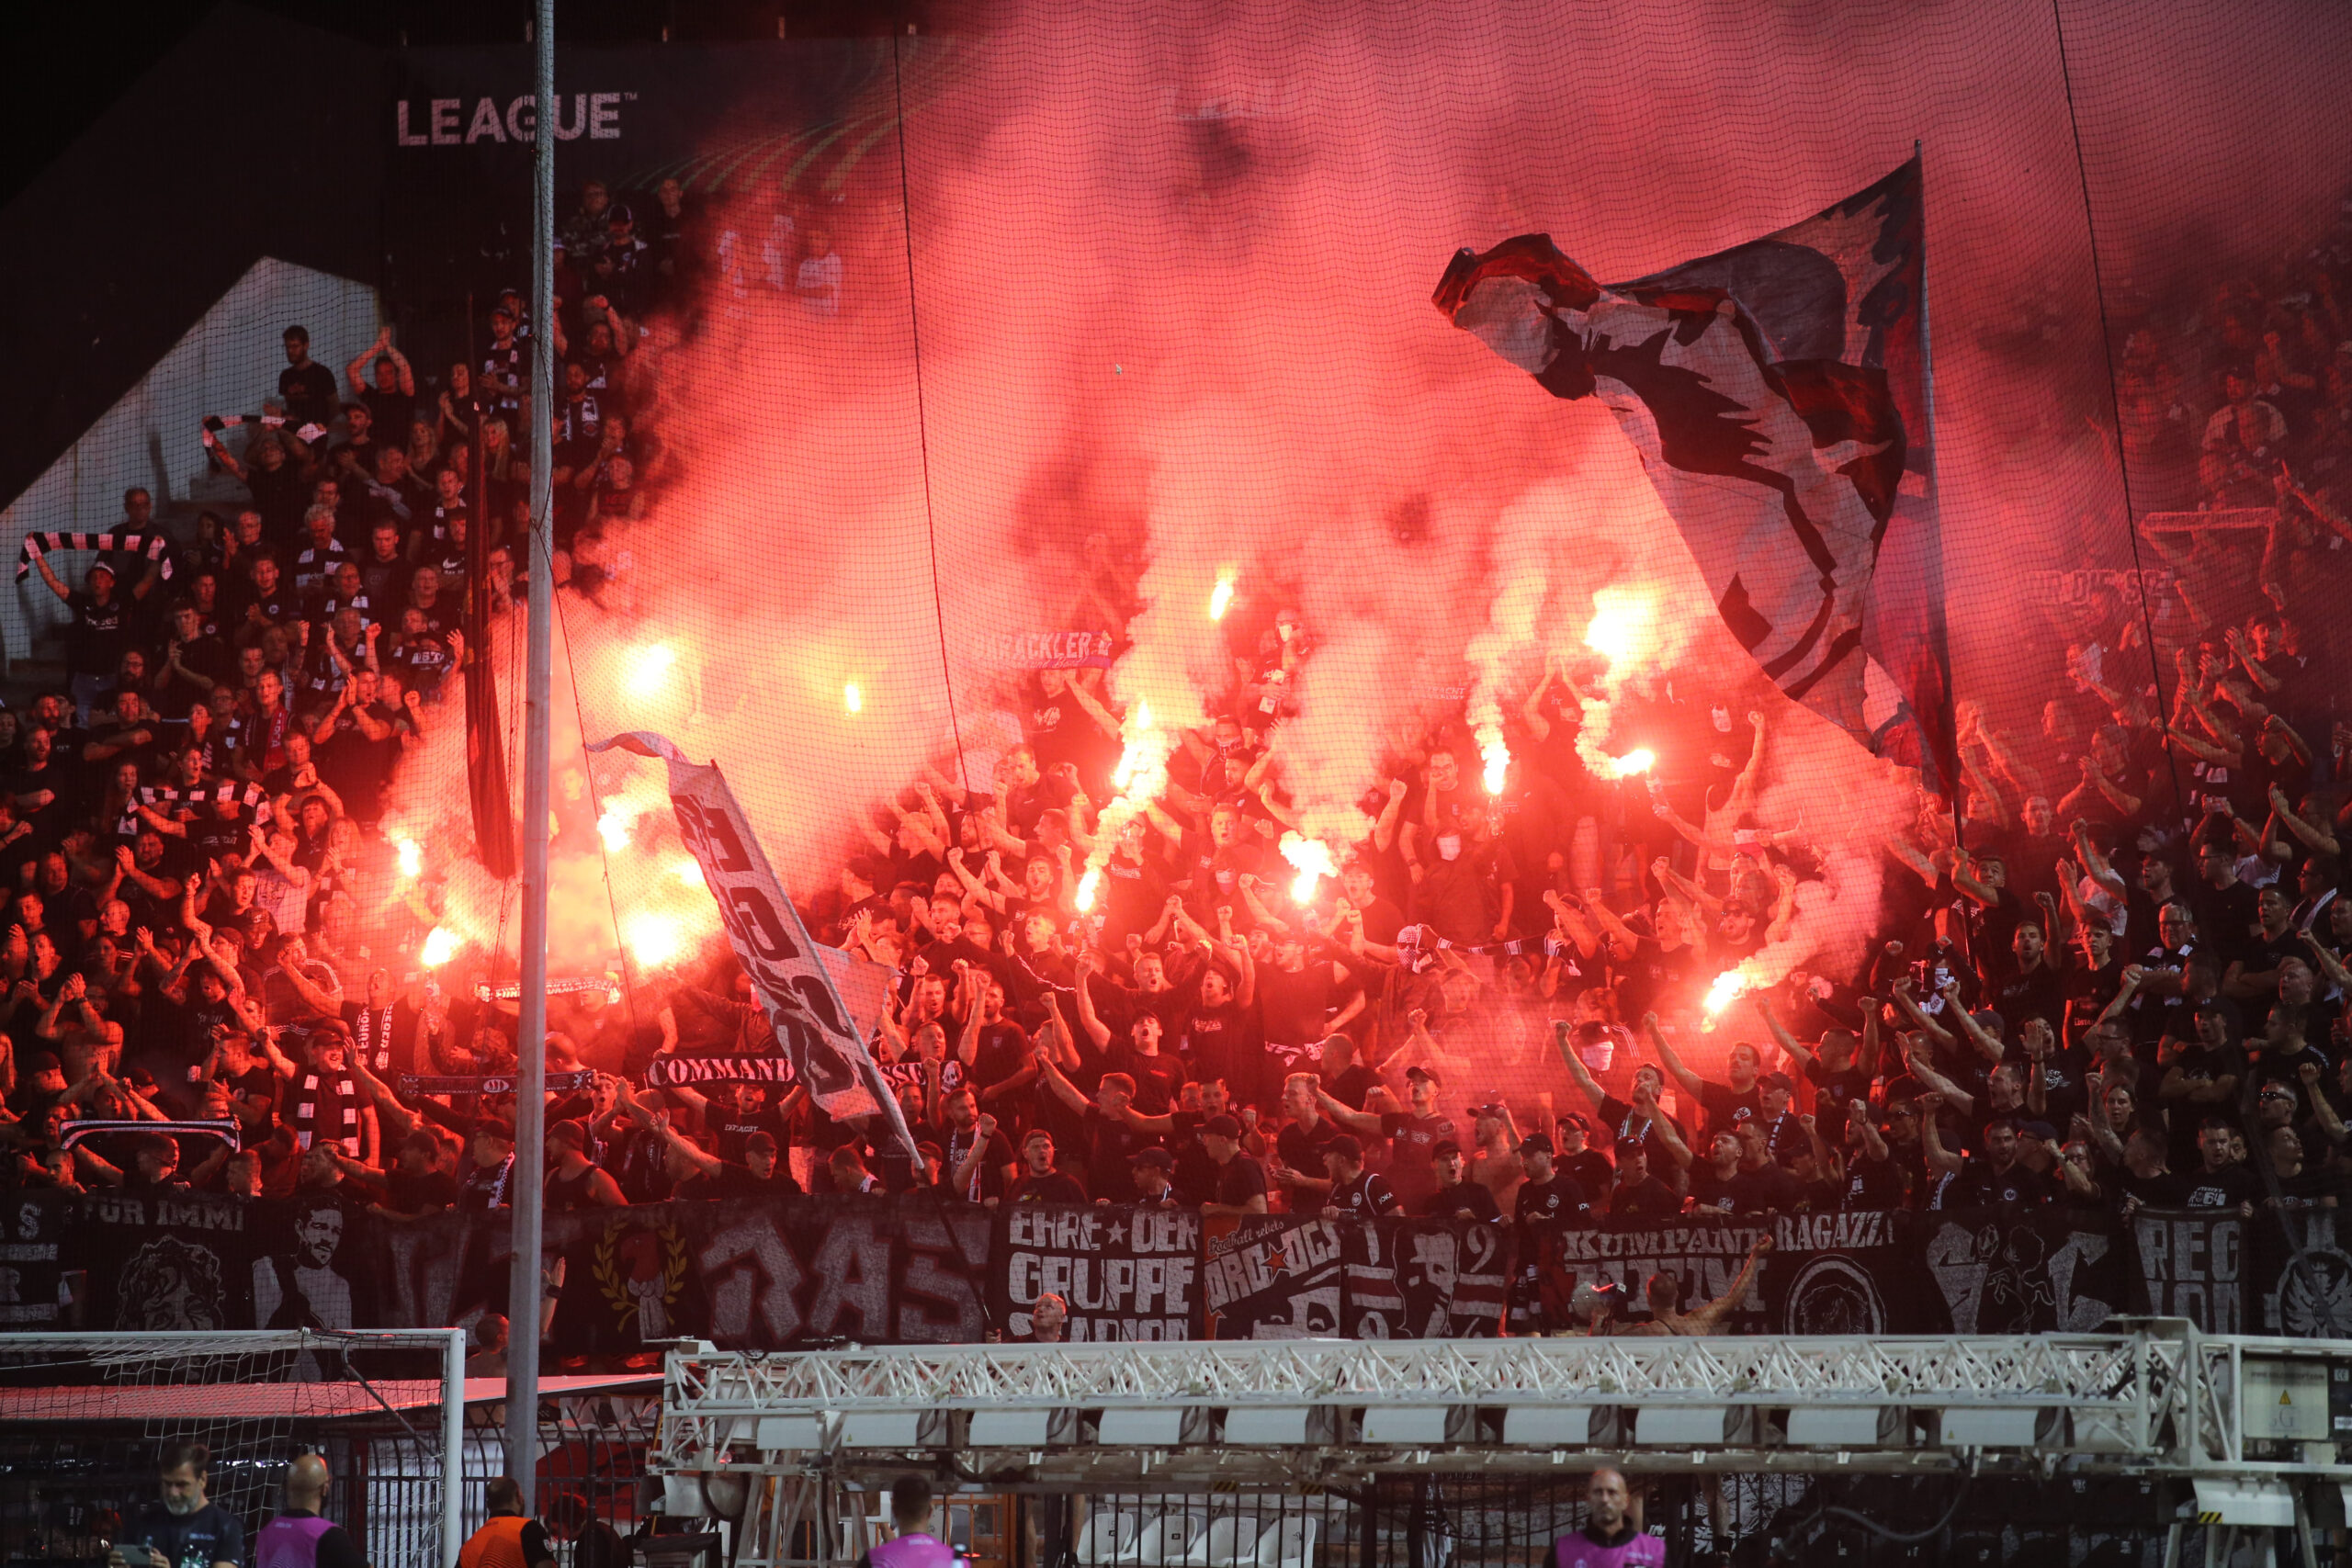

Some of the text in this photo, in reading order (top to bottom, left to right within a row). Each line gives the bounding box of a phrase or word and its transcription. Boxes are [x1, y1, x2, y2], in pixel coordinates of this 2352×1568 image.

[649, 1057, 801, 1087] COMMAND
[2133, 1219, 2242, 1281] REG
[1009, 1251, 1195, 1314] GRUPPE
